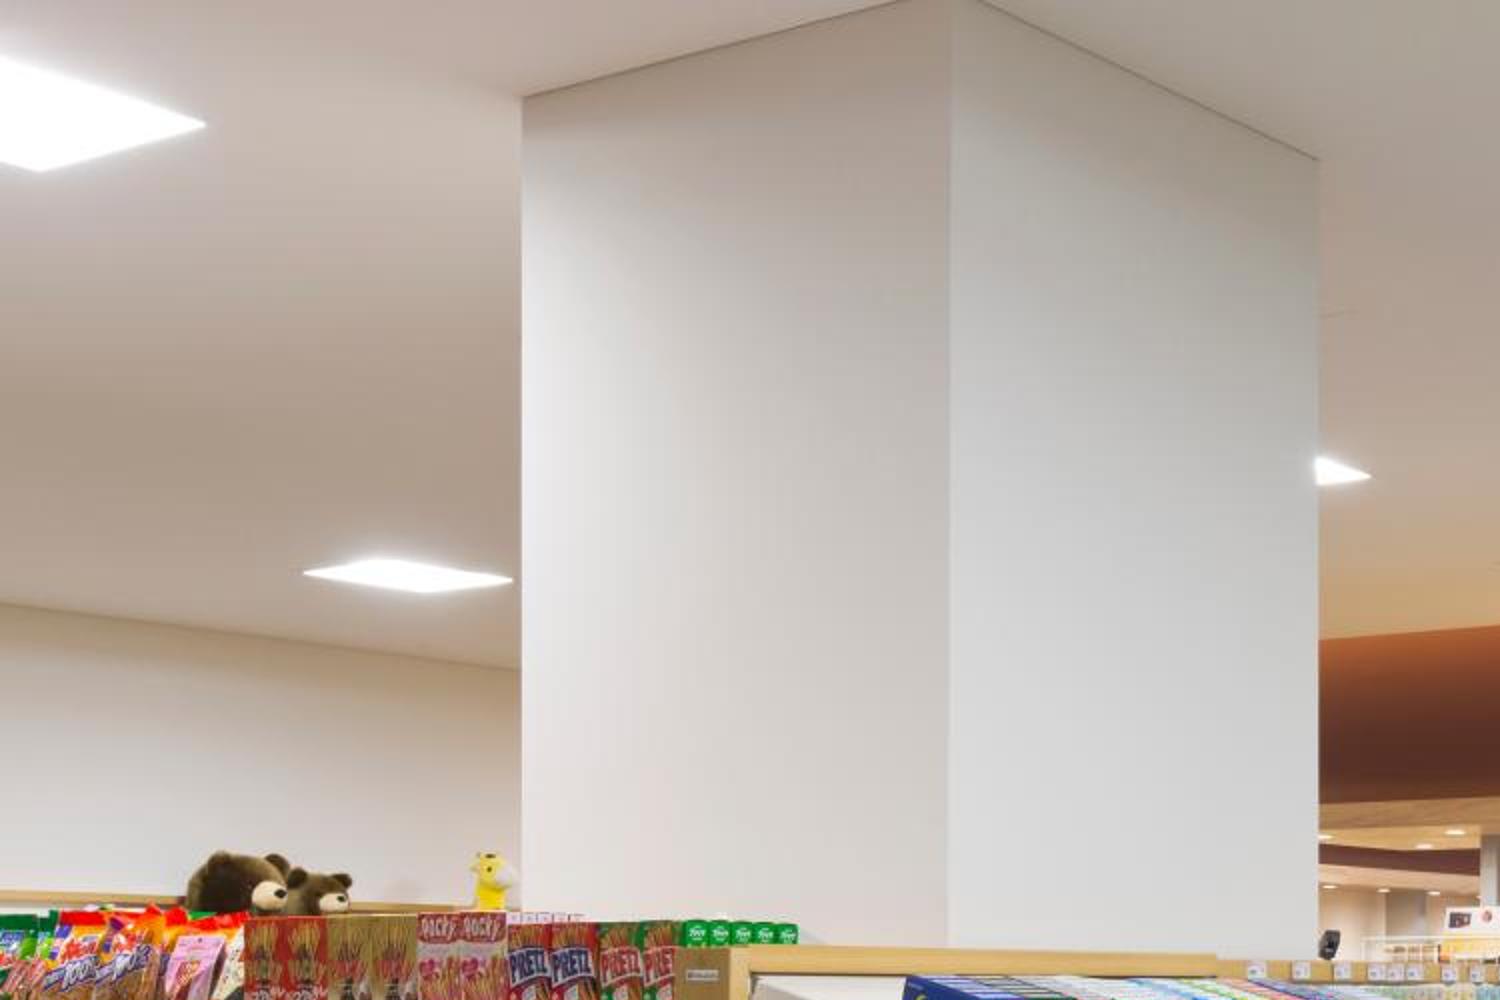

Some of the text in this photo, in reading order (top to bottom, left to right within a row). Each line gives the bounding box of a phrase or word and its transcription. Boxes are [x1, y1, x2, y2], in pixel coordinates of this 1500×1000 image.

[510, 948, 549, 983] PRETZ
[553, 948, 592, 984] PRETZ
[601, 948, 642, 983] PRETZ
